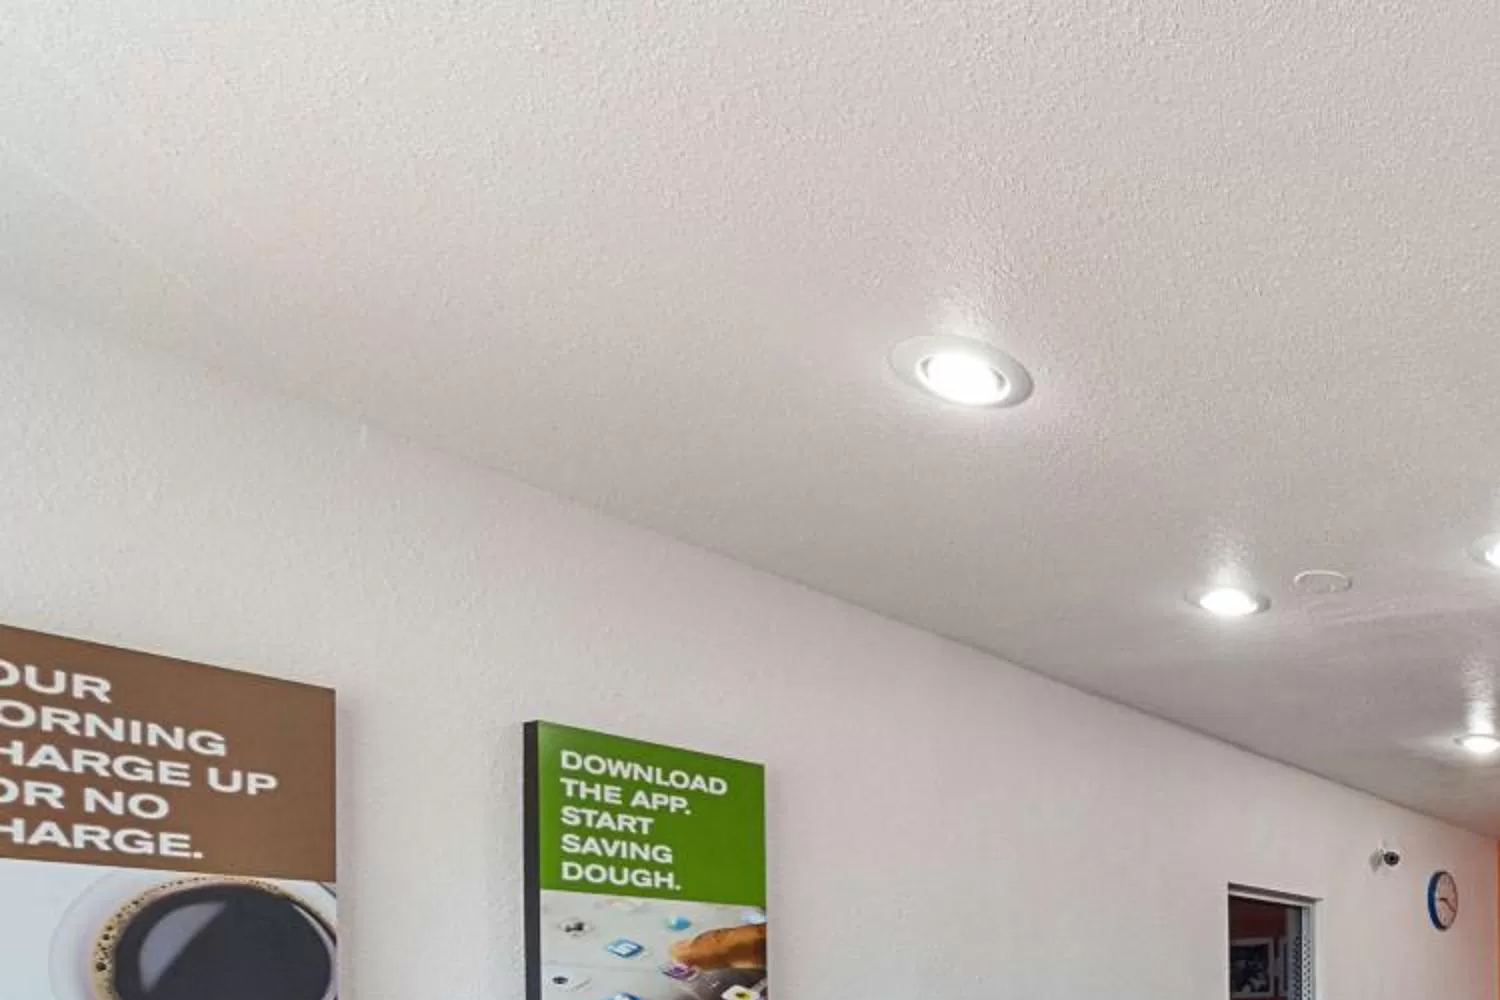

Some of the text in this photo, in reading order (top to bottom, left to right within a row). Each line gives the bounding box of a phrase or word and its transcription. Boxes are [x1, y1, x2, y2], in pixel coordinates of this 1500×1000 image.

[207, 766, 279, 796] UP
[560, 749, 729, 796] DOWNLOAD
[84, 787, 170, 820] NO
[560, 777, 692, 815] THE APP.
[560, 806, 655, 835] START
[560, 833, 673, 865] SAVING
[561, 861, 682, 891] DOUGH.
